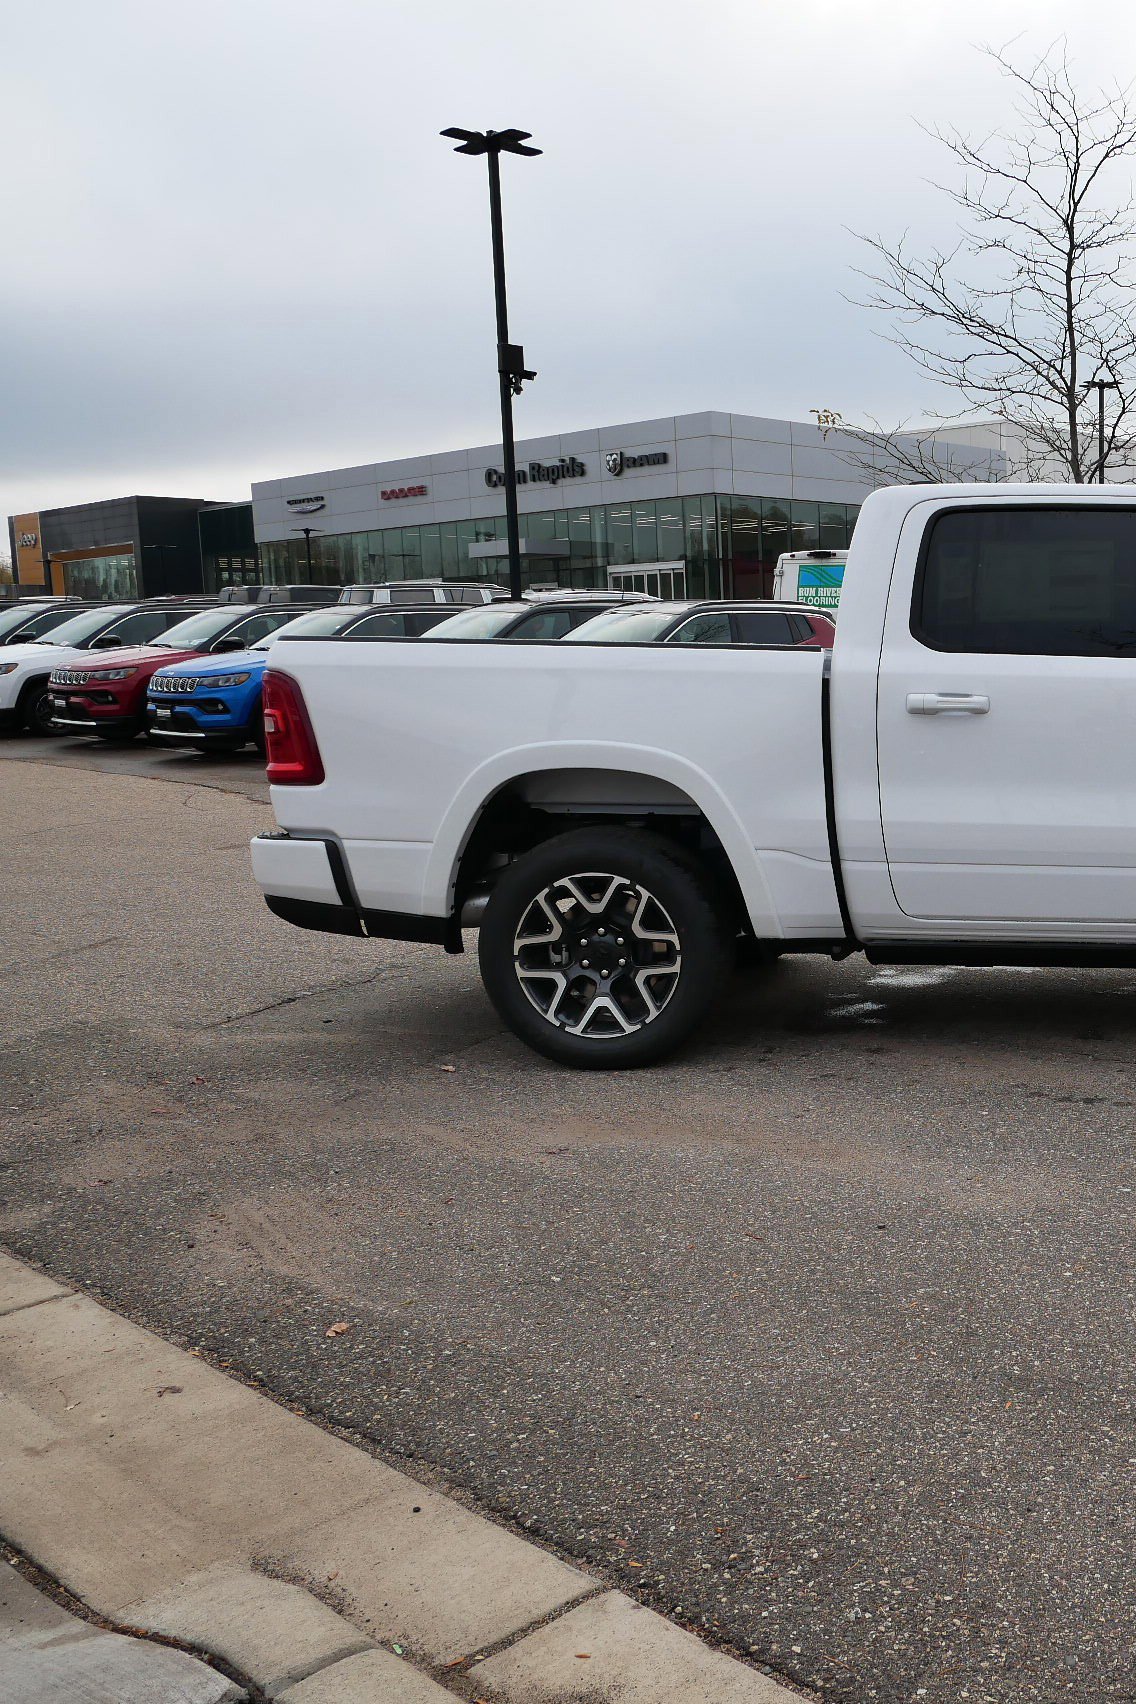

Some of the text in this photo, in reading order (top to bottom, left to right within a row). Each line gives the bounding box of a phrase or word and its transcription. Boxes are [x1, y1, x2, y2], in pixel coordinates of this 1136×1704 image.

[621, 452, 668, 468] RAM
[484, 456, 586, 488] Con Rapids
[381, 484, 428, 500] DODGE
[798, 587, 816, 596] RUM
